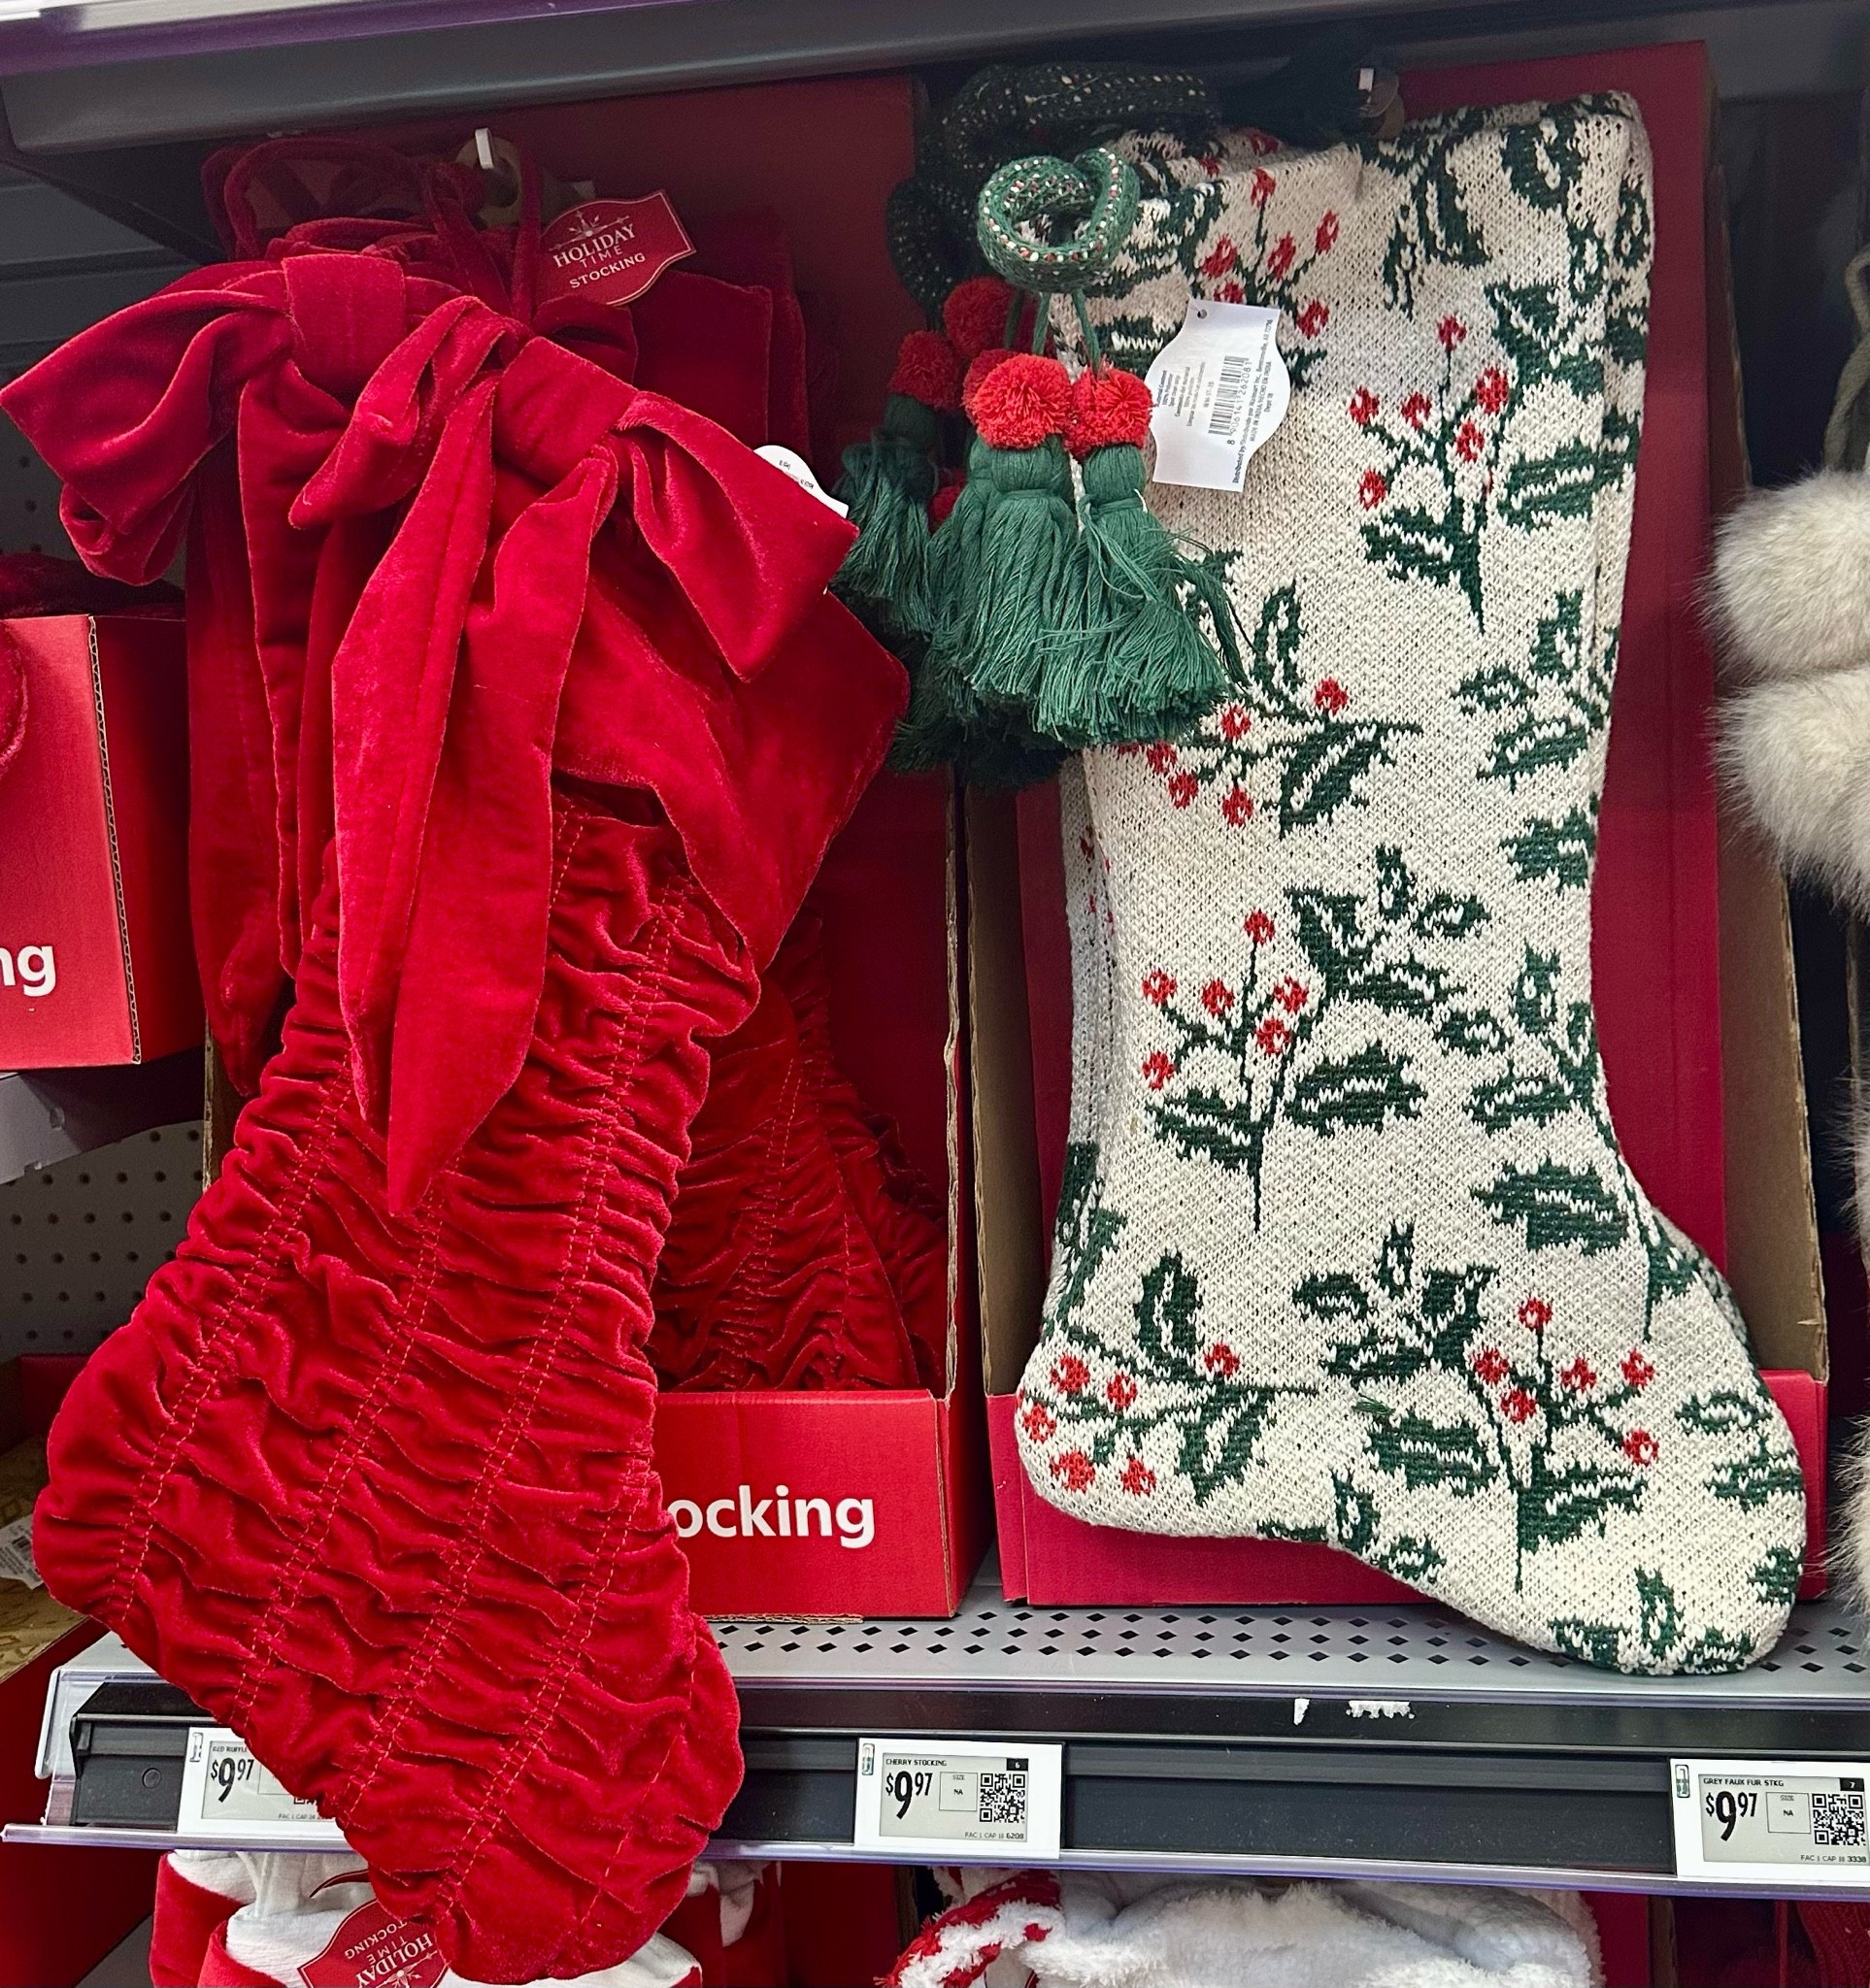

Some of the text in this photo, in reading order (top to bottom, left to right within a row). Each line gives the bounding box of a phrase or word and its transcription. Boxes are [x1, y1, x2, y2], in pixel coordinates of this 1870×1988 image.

[552, 223, 636, 268] HOLIDAY
[580, 245, 623, 268] TIME
[569, 252, 646, 288] STOCKING
[1237, 361, 1252, 394] 262081
[667, 1484, 875, 1548] ocking
[344, 1920, 408, 1960] TOCKING
[368, 1937, 407, 1964] TIME
[355, 1933, 434, 1988] HOLIDAY
